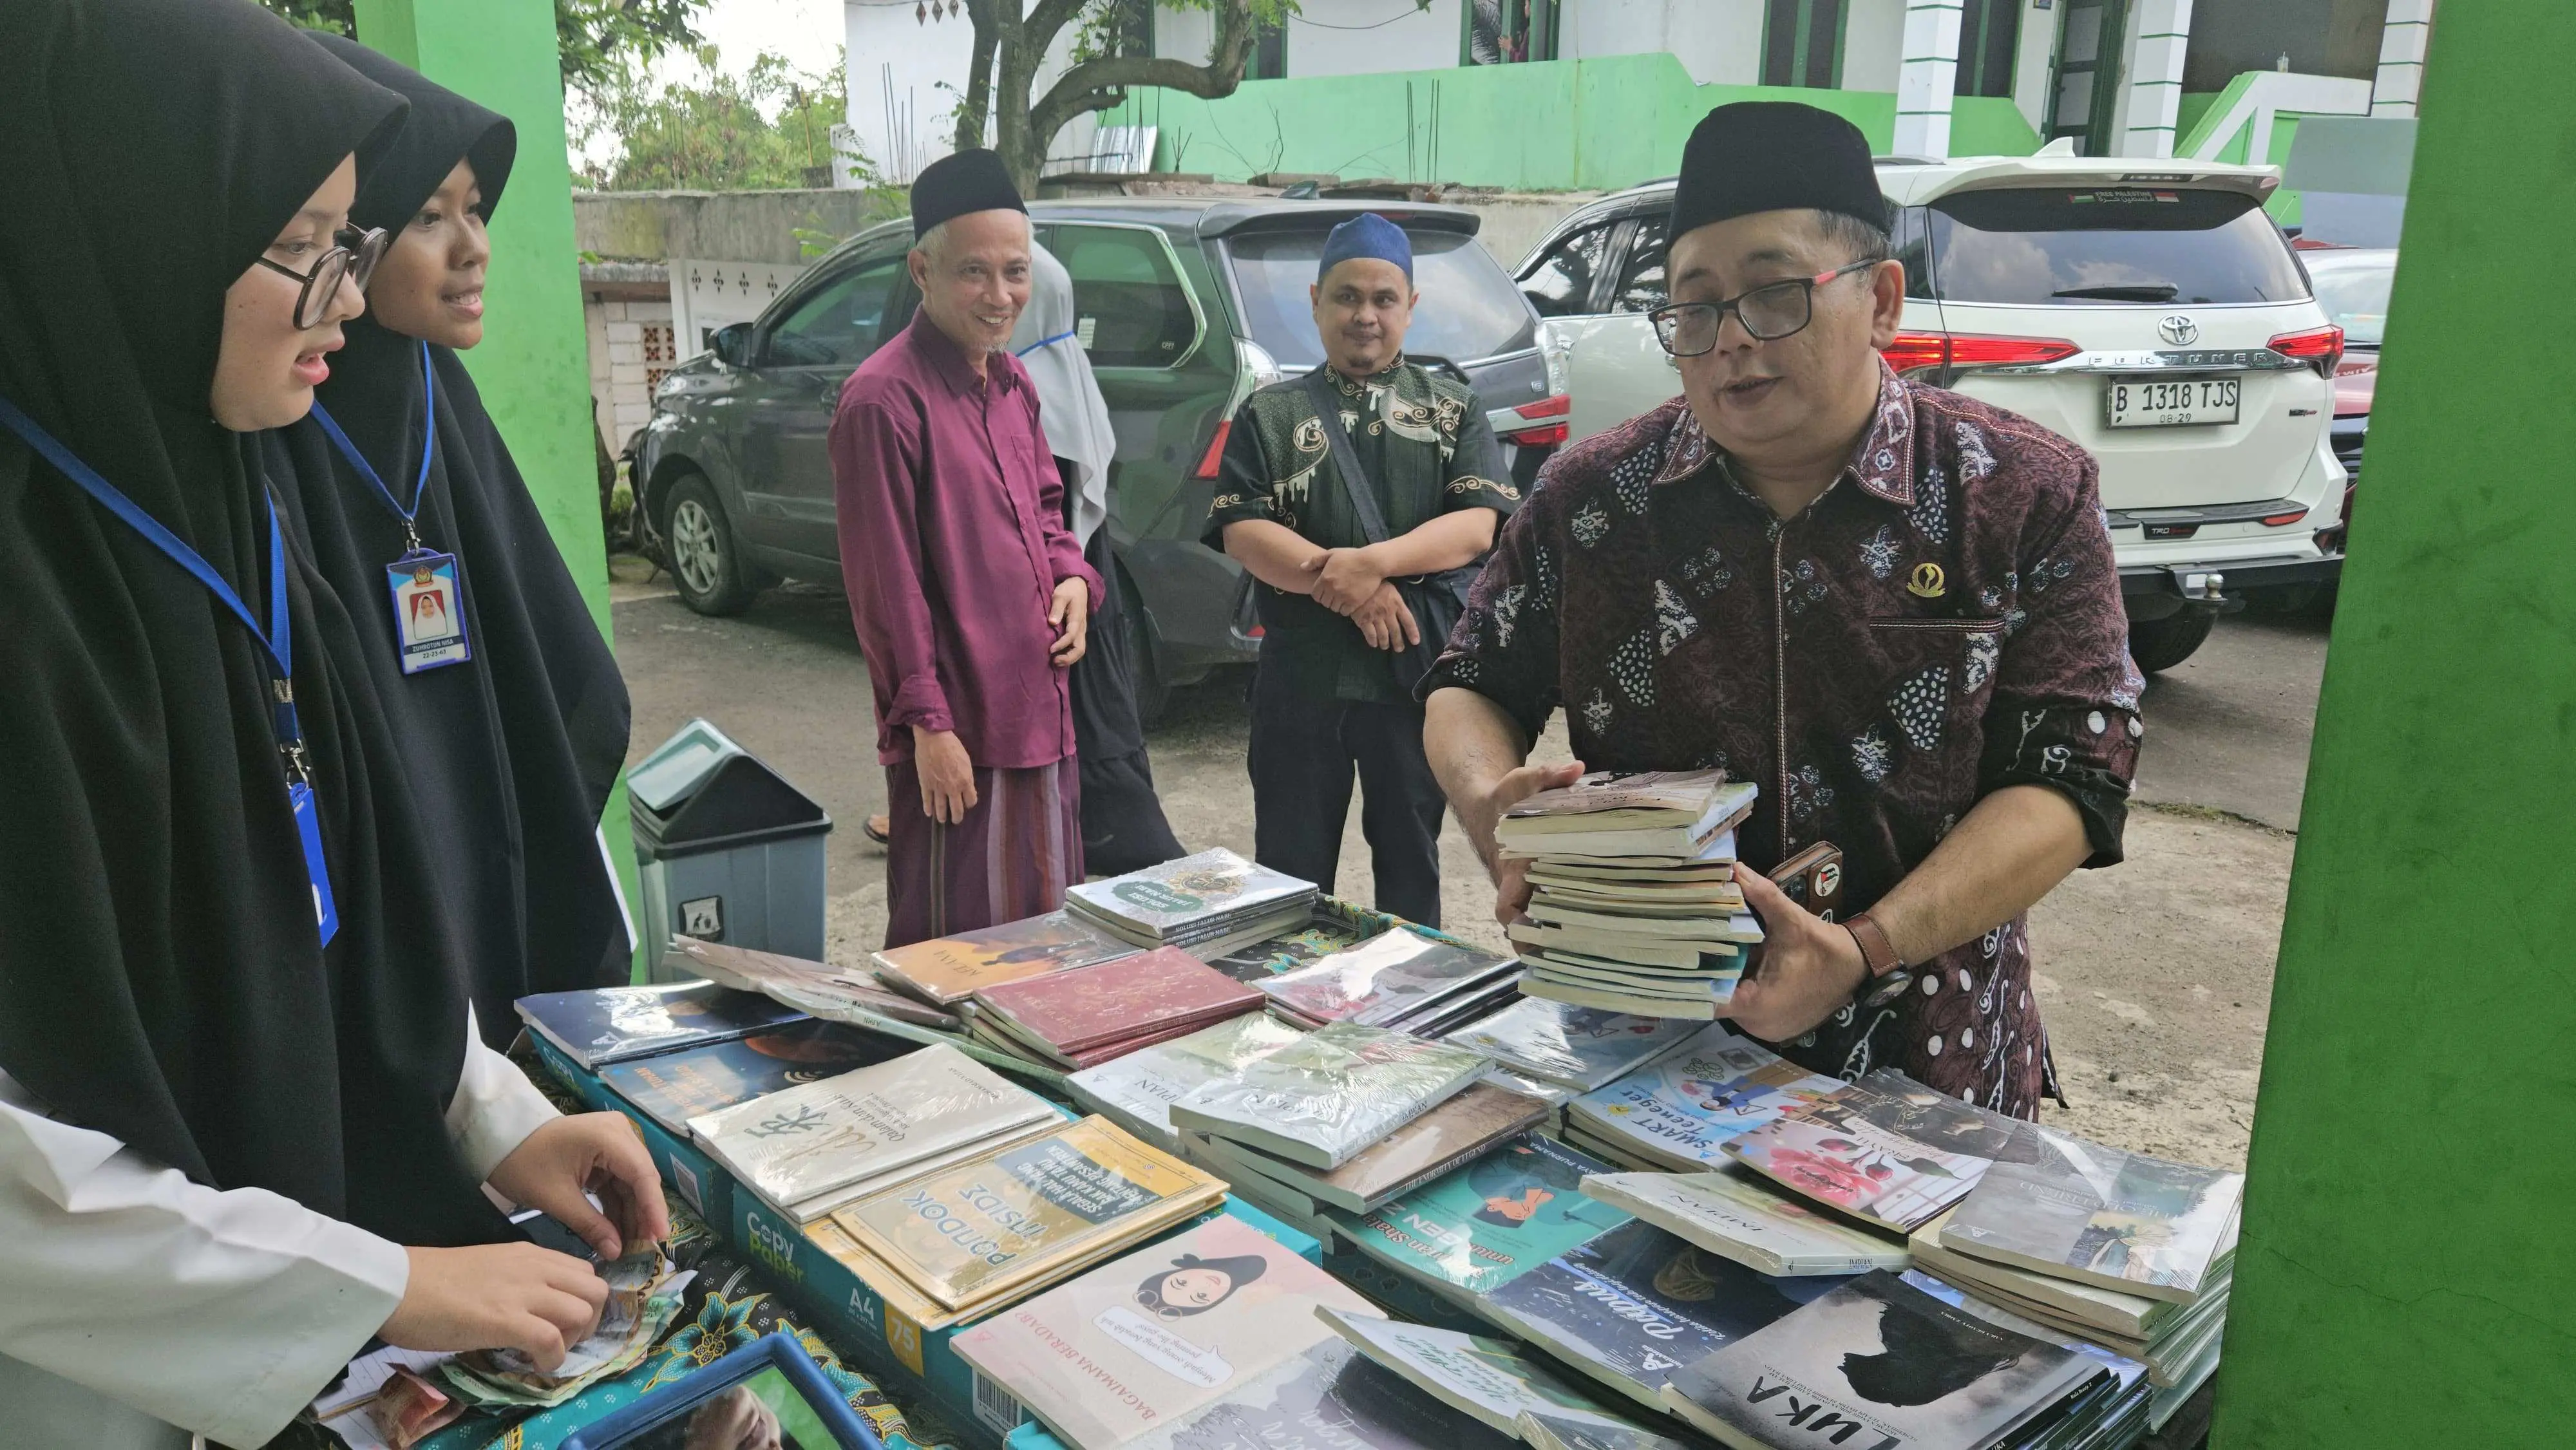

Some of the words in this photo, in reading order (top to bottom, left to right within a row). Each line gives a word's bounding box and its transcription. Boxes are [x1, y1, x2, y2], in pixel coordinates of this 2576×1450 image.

[2088, 352, 2268, 365] FORTUNER
[2116, 386, 2128, 412] B
[2143, 384, 2191, 411] 1318
[2201, 381, 2237, 408] TJS
[1401, 1101, 1428, 1121] IMPIAN
[1620, 1091, 1705, 1135] Teeneger
[867, 1116, 907, 1145] Qalam
[1631, 1118, 1713, 1149] SMART
[1045, 1144, 1101, 1182] PESANTREN
[1530, 1142, 1576, 1167] PURNAMA
[2018, 1180, 2092, 1208] FRIEND
[747, 1212, 794, 1262] Copy
[749, 1232, 804, 1283] Paper
[849, 1288, 875, 1321] A4
[891, 1316, 914, 1351] 75
[1015, 1310, 1079, 1360] BERADAB?
[1077, 1356, 1157, 1421] BAGAIMANA
[1747, 1376, 1901, 1450] LUKA
